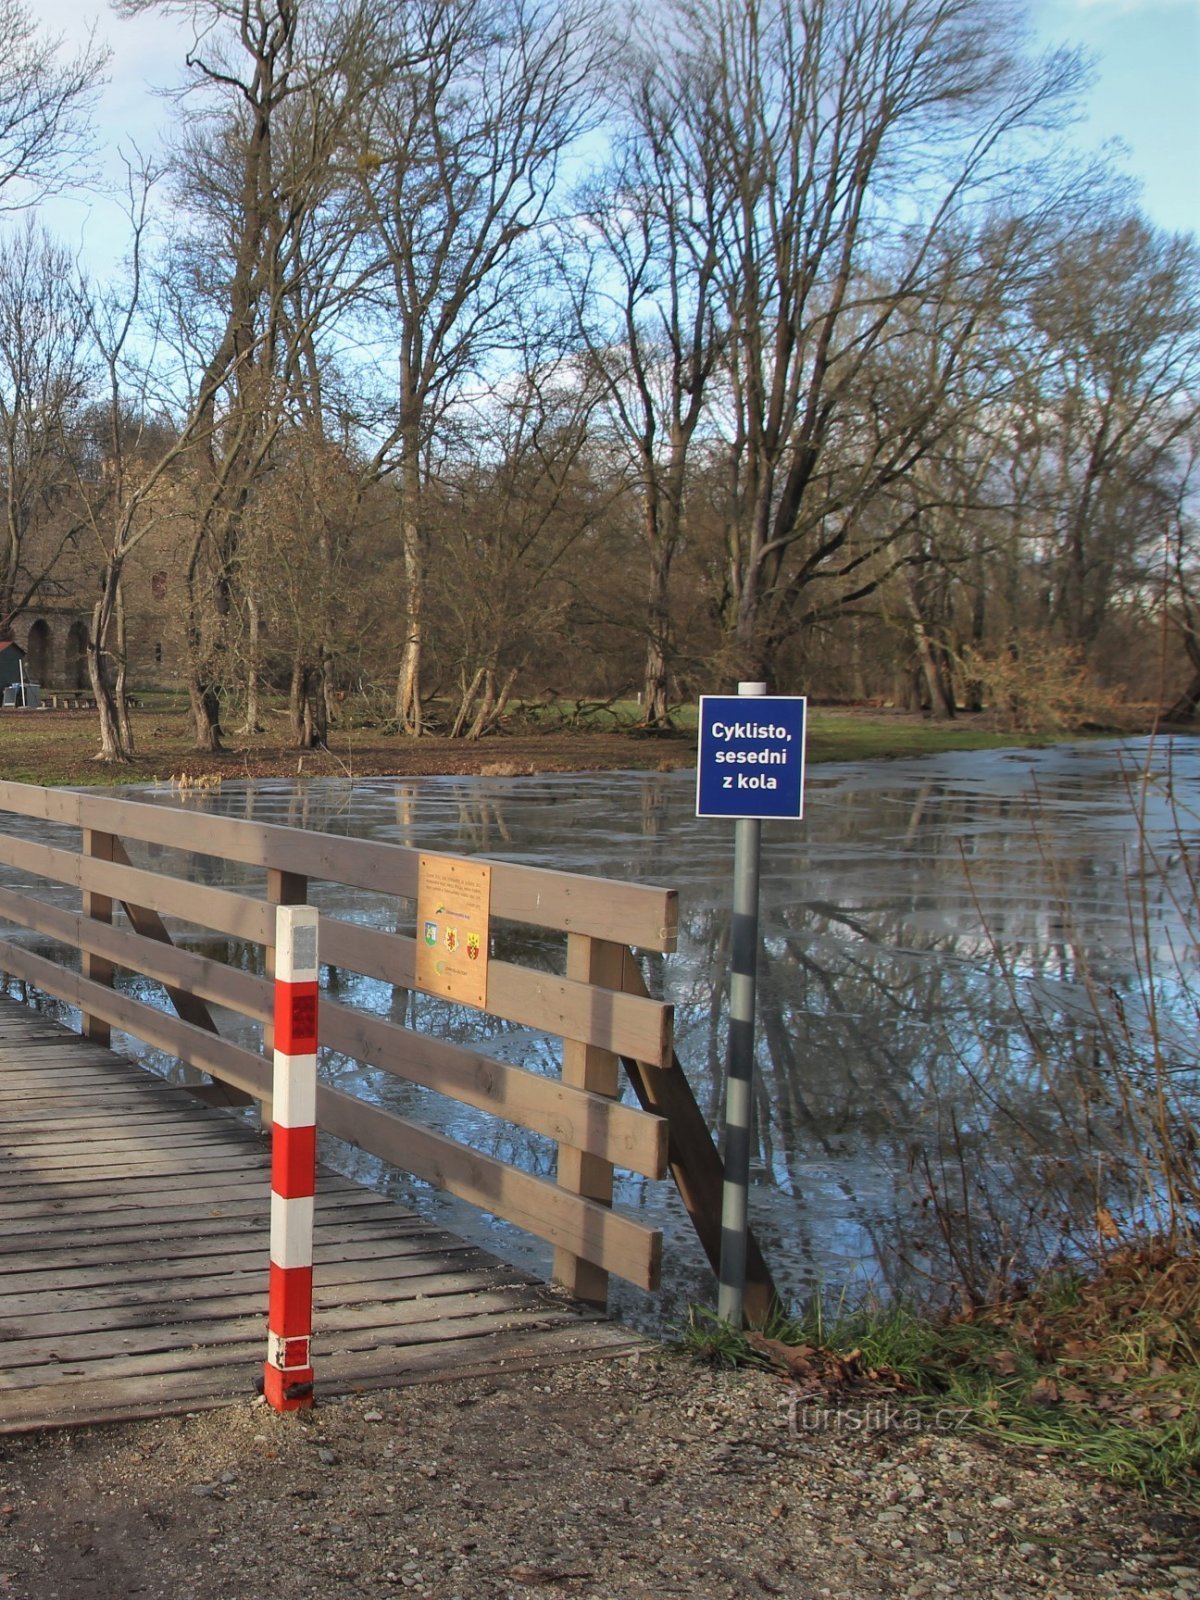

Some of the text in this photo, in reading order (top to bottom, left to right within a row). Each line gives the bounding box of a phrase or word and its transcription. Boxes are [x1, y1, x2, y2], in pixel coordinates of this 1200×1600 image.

[711, 722, 792, 742] Cyklisto,
[714, 748, 787, 764] sesedni
[722, 773, 777, 790] z kola
